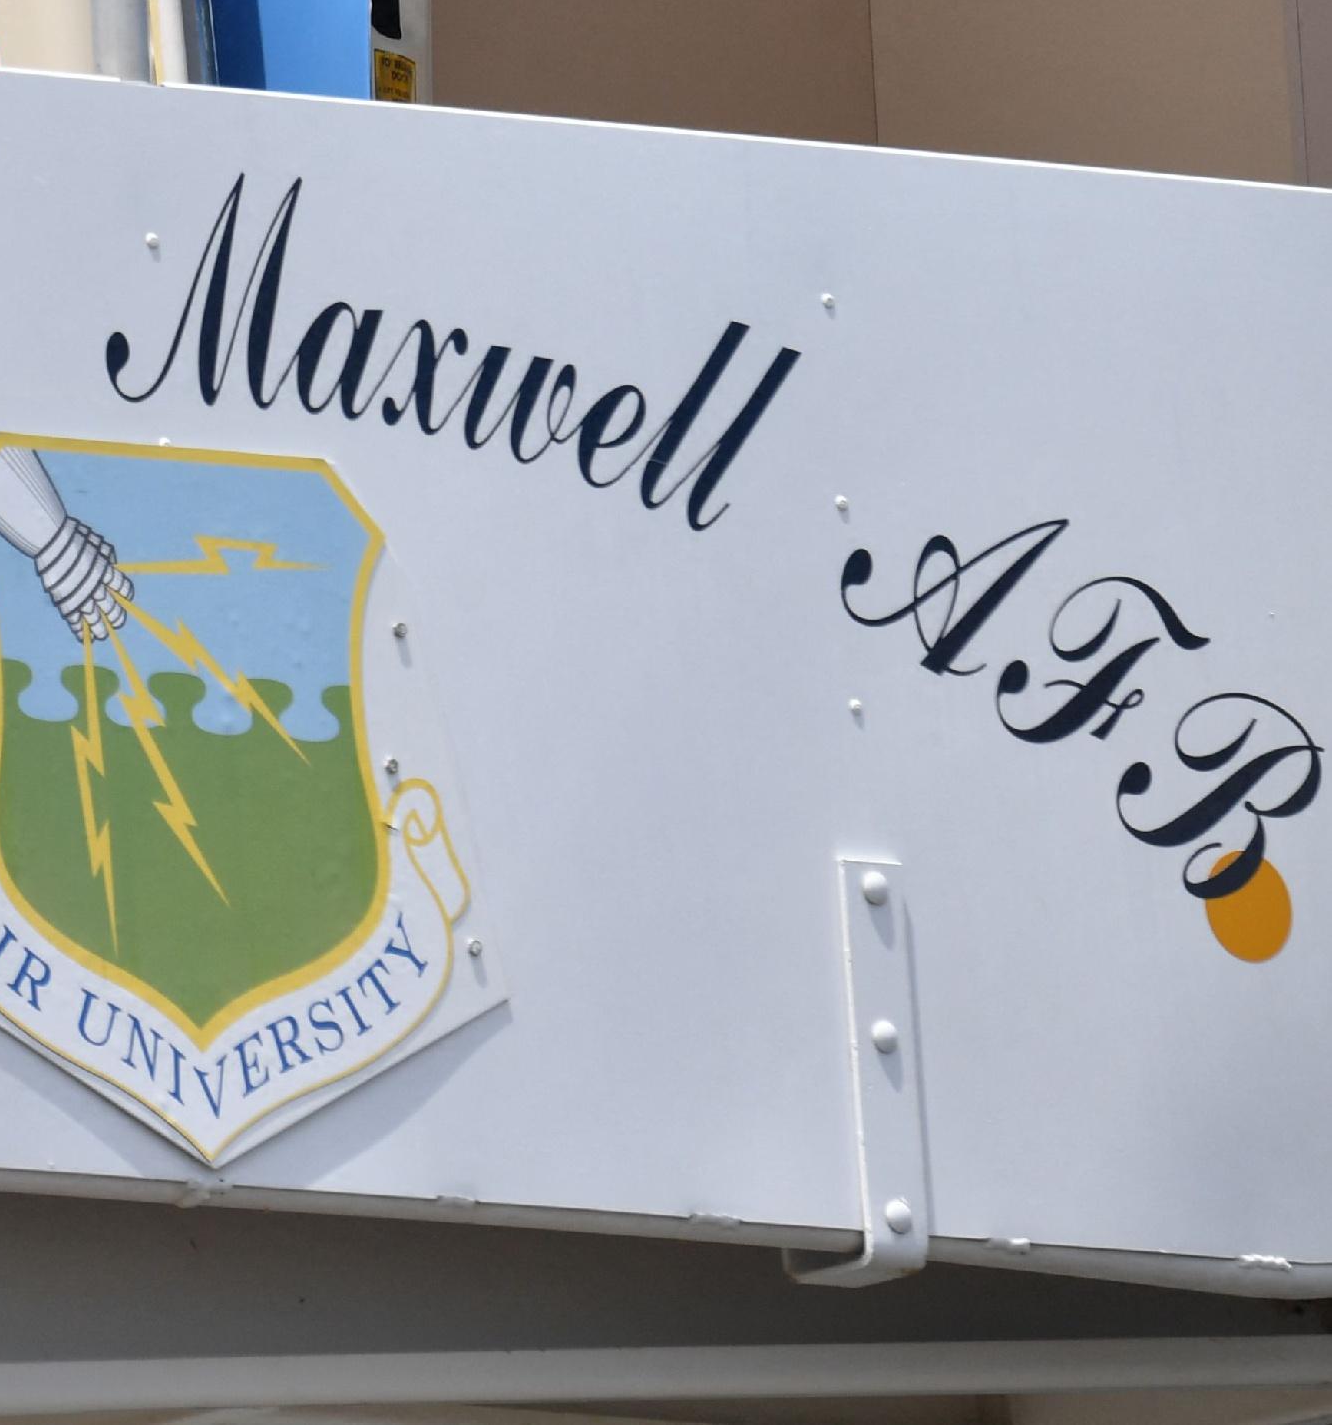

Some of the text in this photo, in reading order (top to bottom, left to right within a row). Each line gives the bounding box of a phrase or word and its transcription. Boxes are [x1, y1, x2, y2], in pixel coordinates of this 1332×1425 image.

[105, 172, 802, 531] Maxwell
[840, 518, 1325, 900] AFB
[78, 911, 429, 1119] UNIVERSITY
